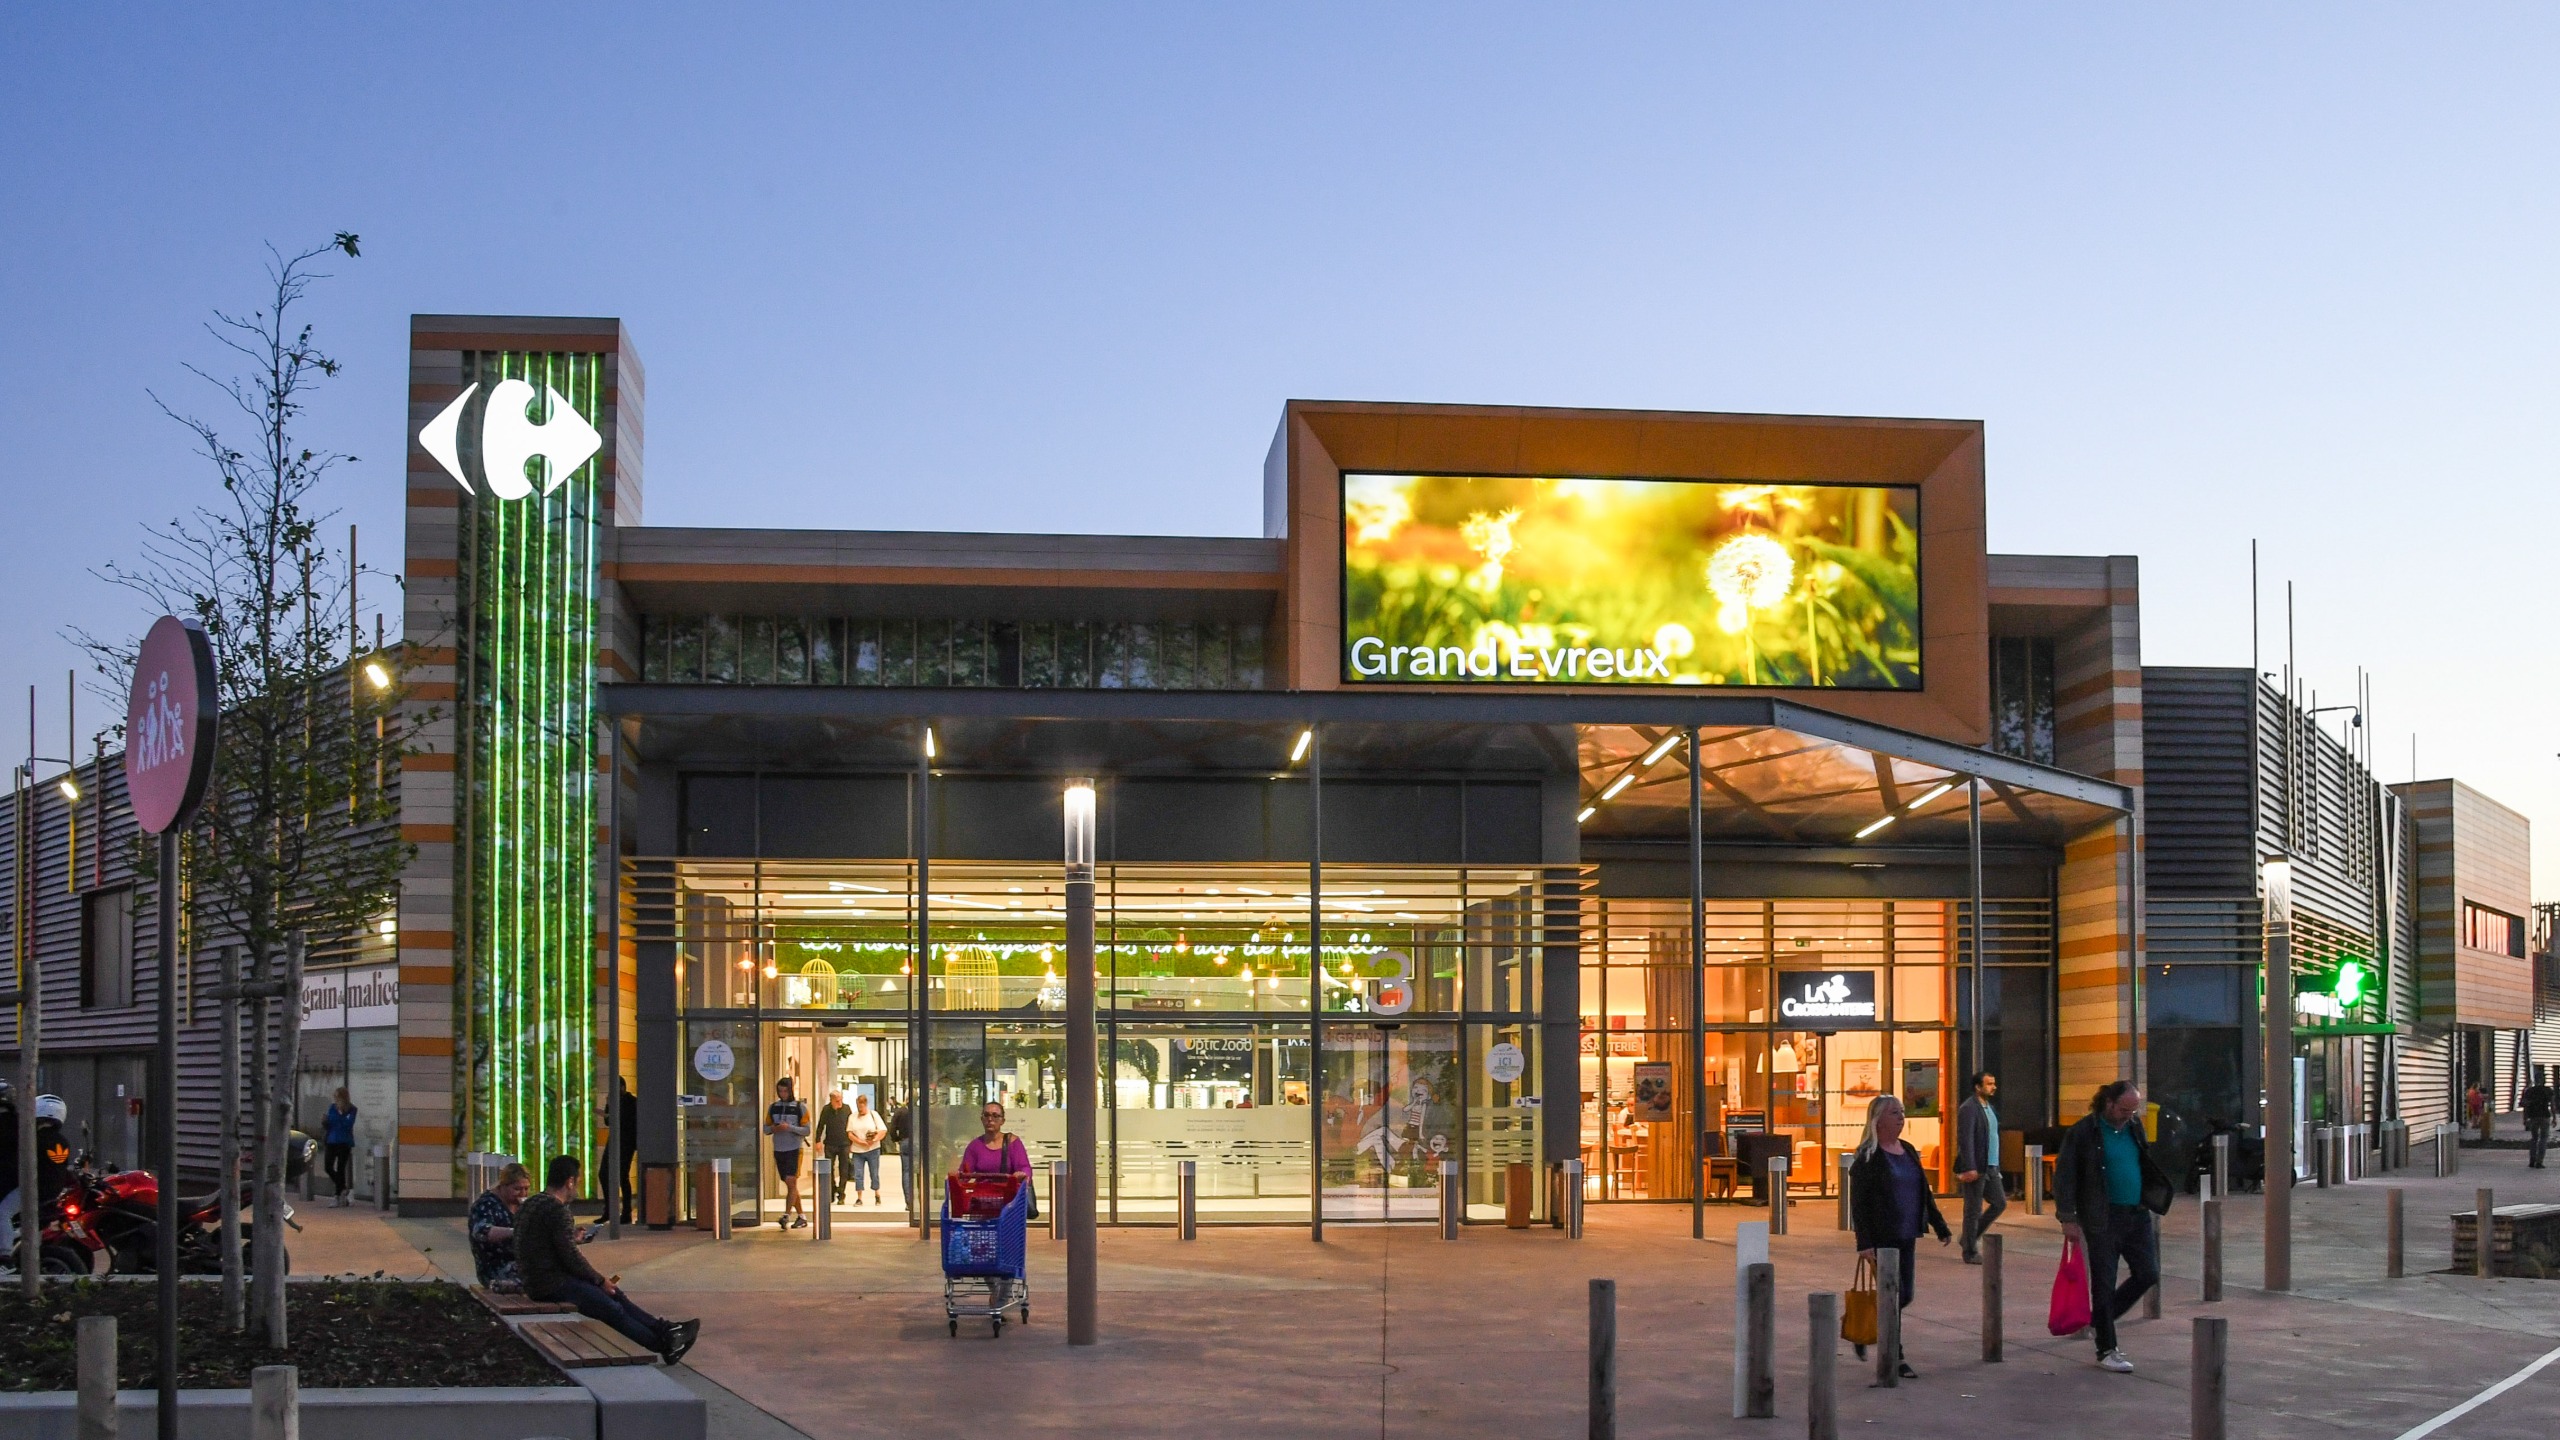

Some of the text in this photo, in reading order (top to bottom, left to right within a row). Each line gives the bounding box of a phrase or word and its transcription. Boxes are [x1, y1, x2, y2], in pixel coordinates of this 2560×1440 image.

[1351, 636, 1670, 677] Grand Evreux
[302, 977, 338, 1021] grain
[347, 971, 399, 1008] malice
[1366, 950, 1413, 1015] 3
[1804, 983, 1826, 1003] LA
[1185, 1037, 1253, 1055] Optic 2000
